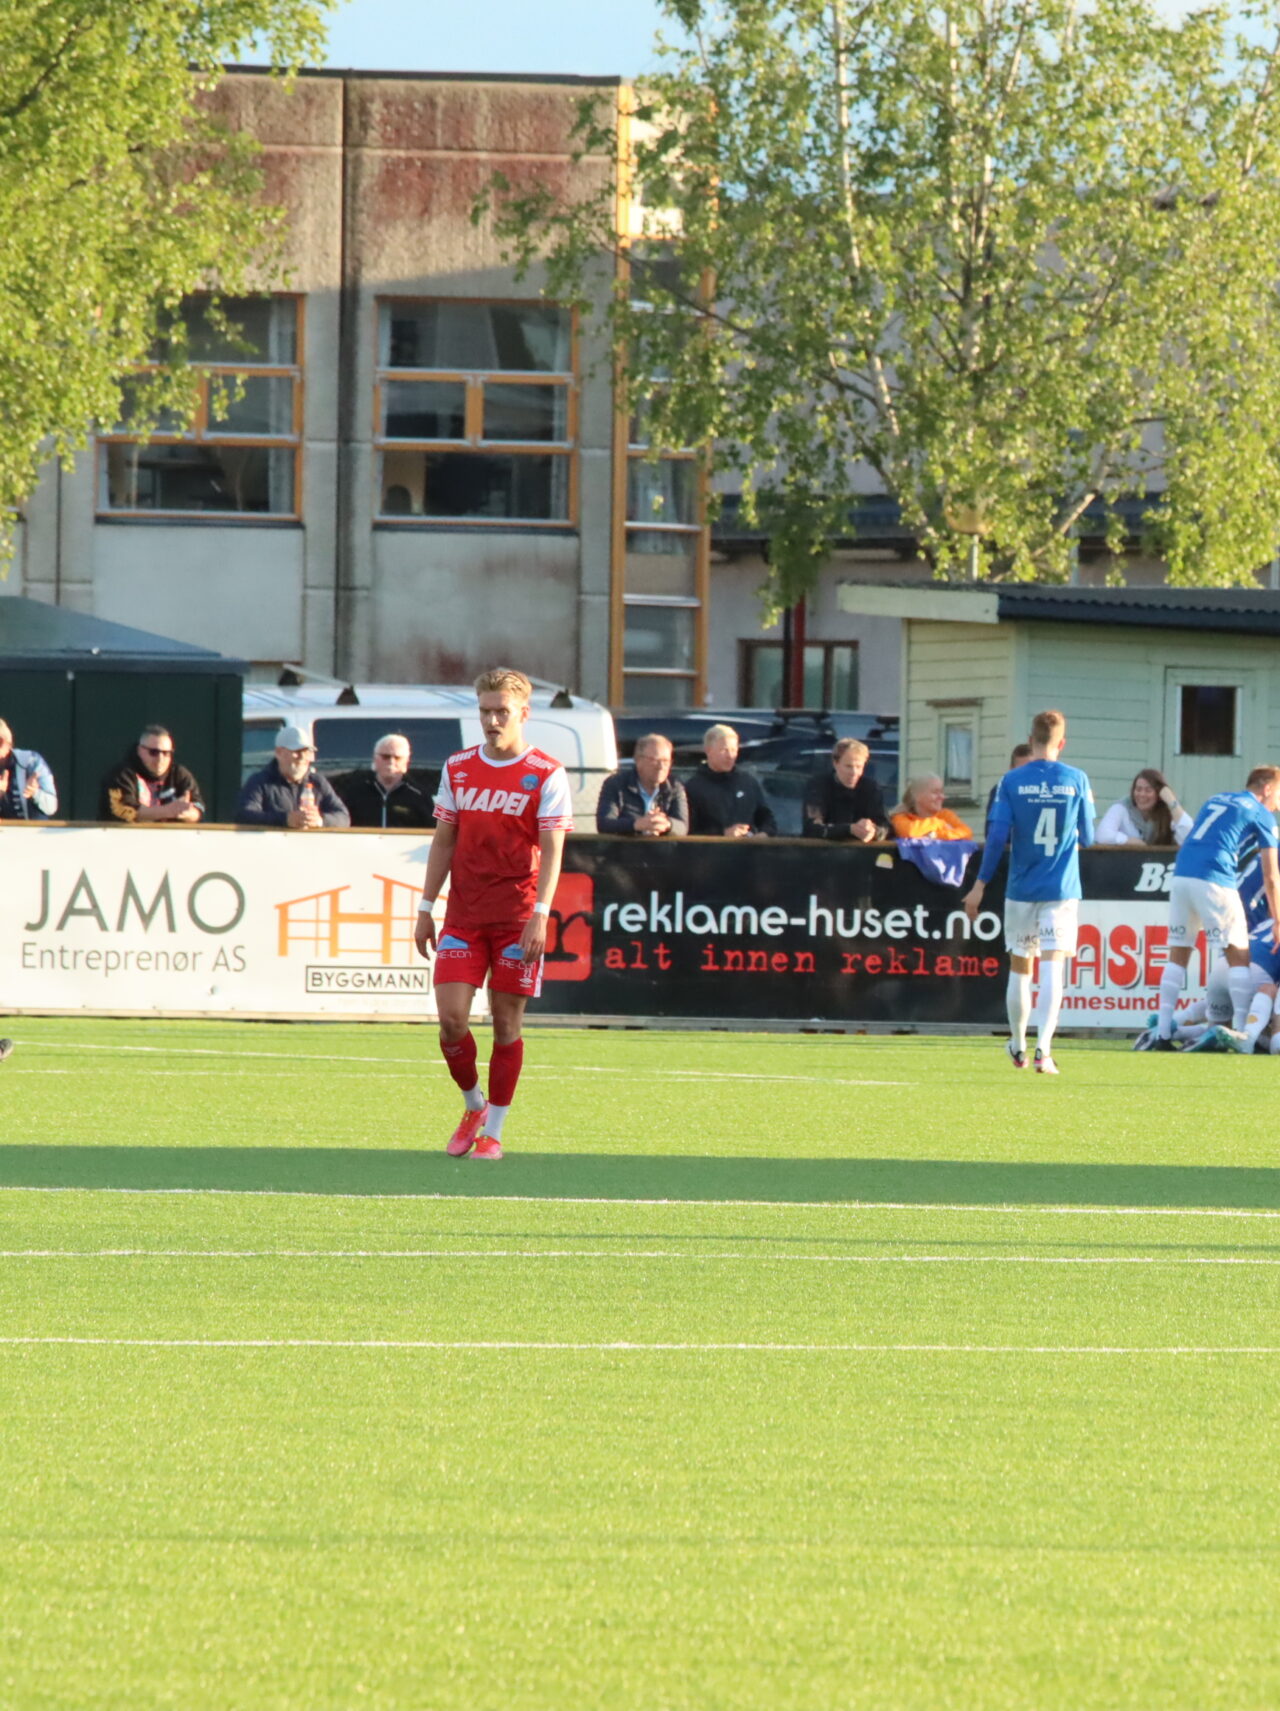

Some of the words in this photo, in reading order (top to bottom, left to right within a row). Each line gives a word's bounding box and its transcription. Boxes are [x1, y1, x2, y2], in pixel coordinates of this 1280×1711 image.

[456, 786, 531, 817] MAPEI
[1033, 807, 1058, 857] 4
[1192, 803, 1228, 841] 7
[24, 867, 246, 936] JAMO
[603, 890, 1002, 941] reklame-huset.no
[22, 941, 203, 978] Entreprenør
[211, 944, 247, 973] AS
[604, 941, 673, 970] alt
[700, 944, 816, 973] innen
[840, 947, 1000, 977] reklame
[311, 971, 425, 989] BYGGMANN
